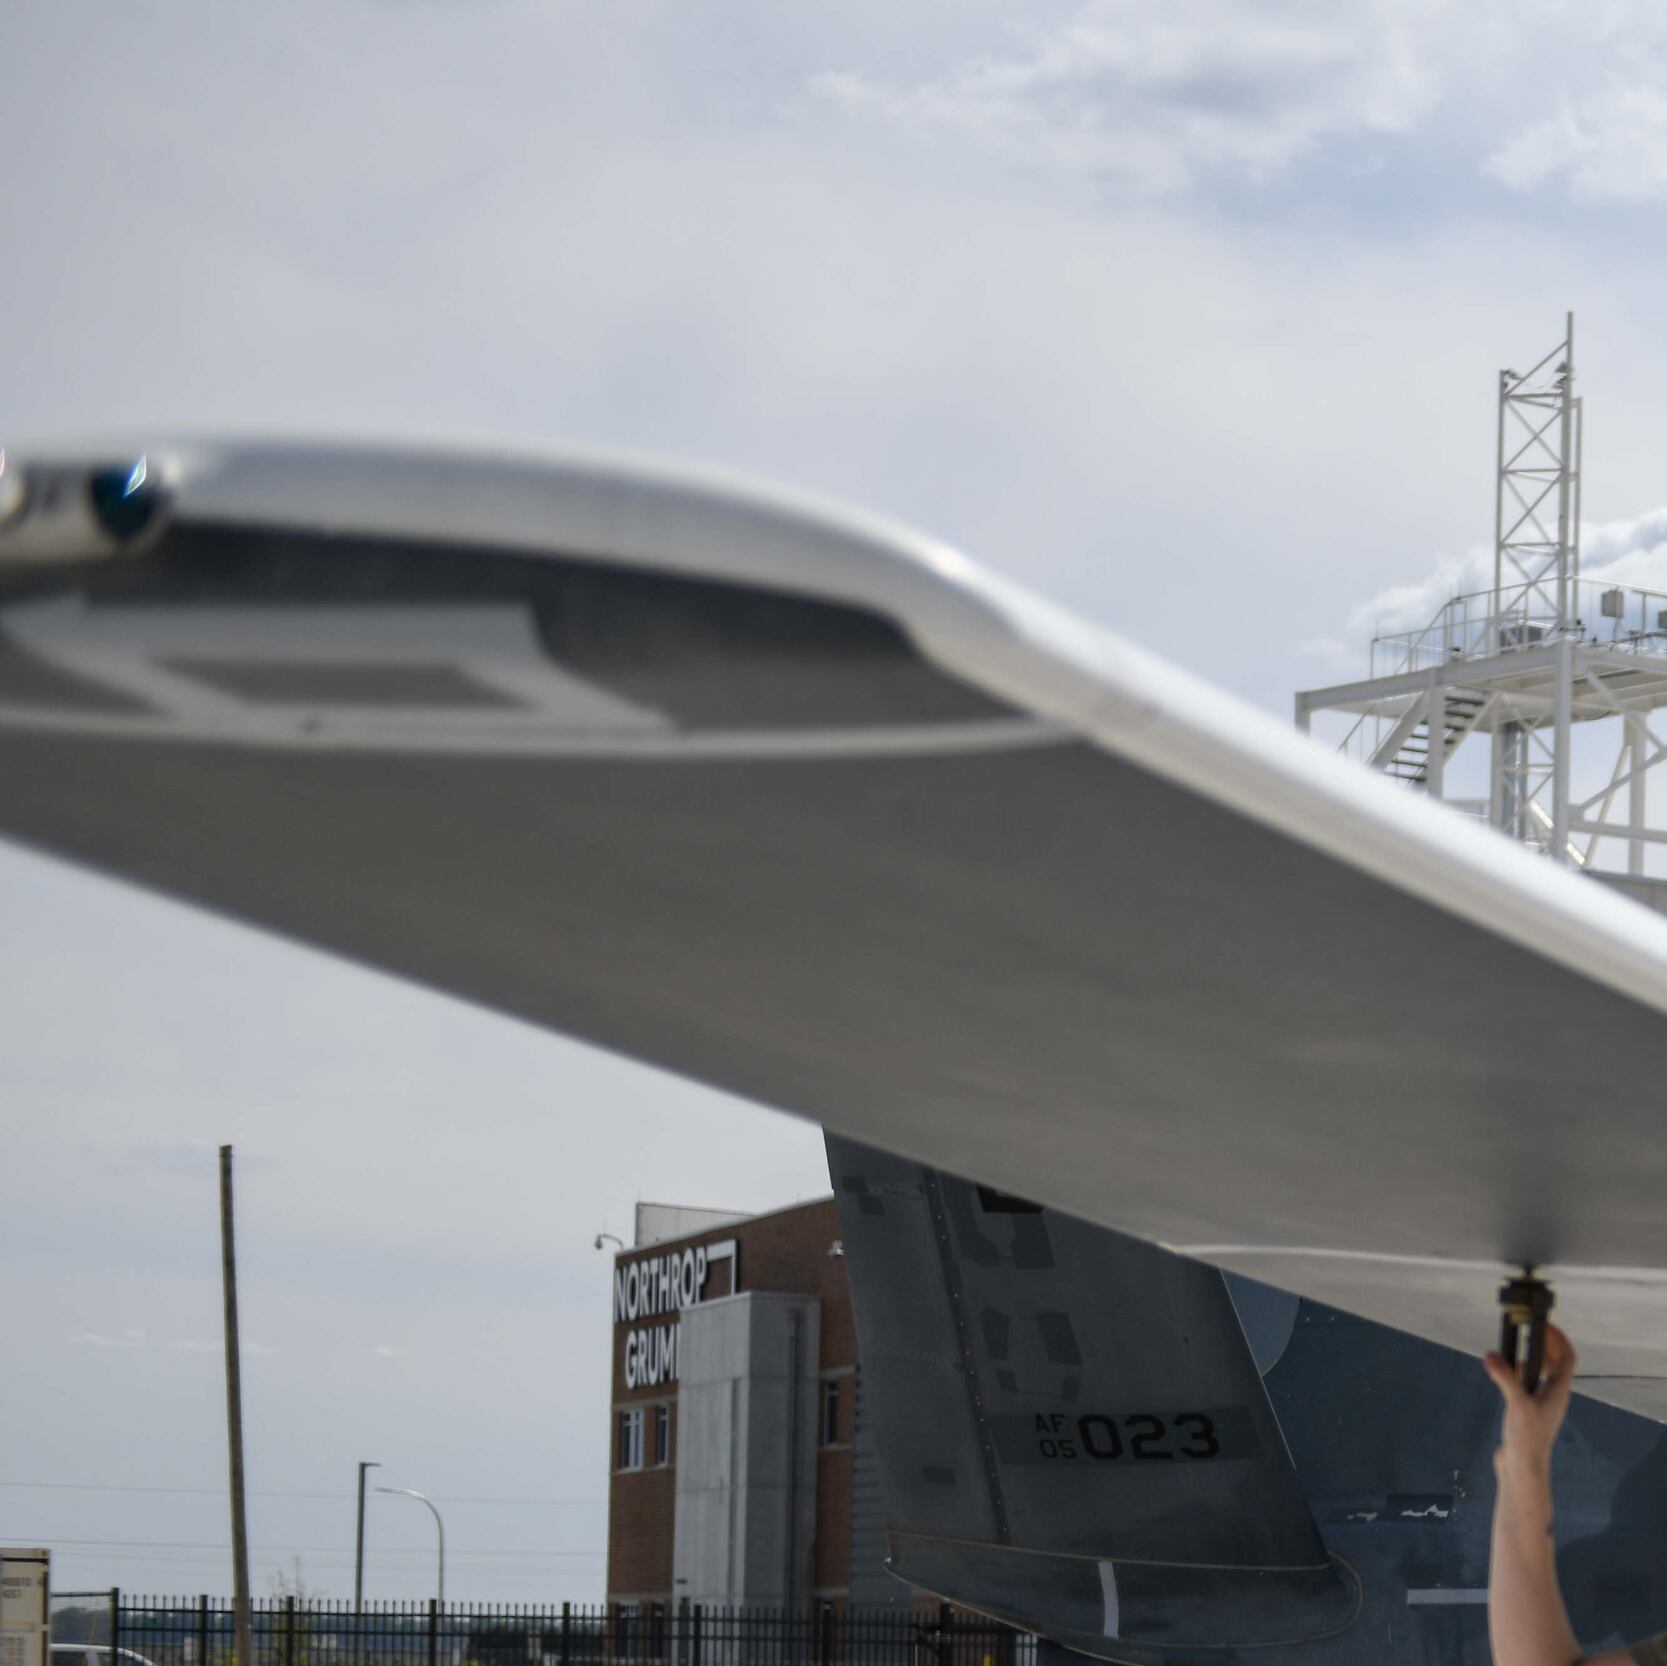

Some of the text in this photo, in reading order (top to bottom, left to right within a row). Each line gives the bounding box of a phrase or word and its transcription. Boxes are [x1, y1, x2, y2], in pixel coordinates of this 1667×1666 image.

[615, 1246, 708, 1322] NORTHROP
[625, 1323, 680, 1390] GRUM
[1035, 1413, 1065, 1433] AF
[1077, 1412, 1221, 1459] 023
[1039, 1438, 1077, 1459] 05
